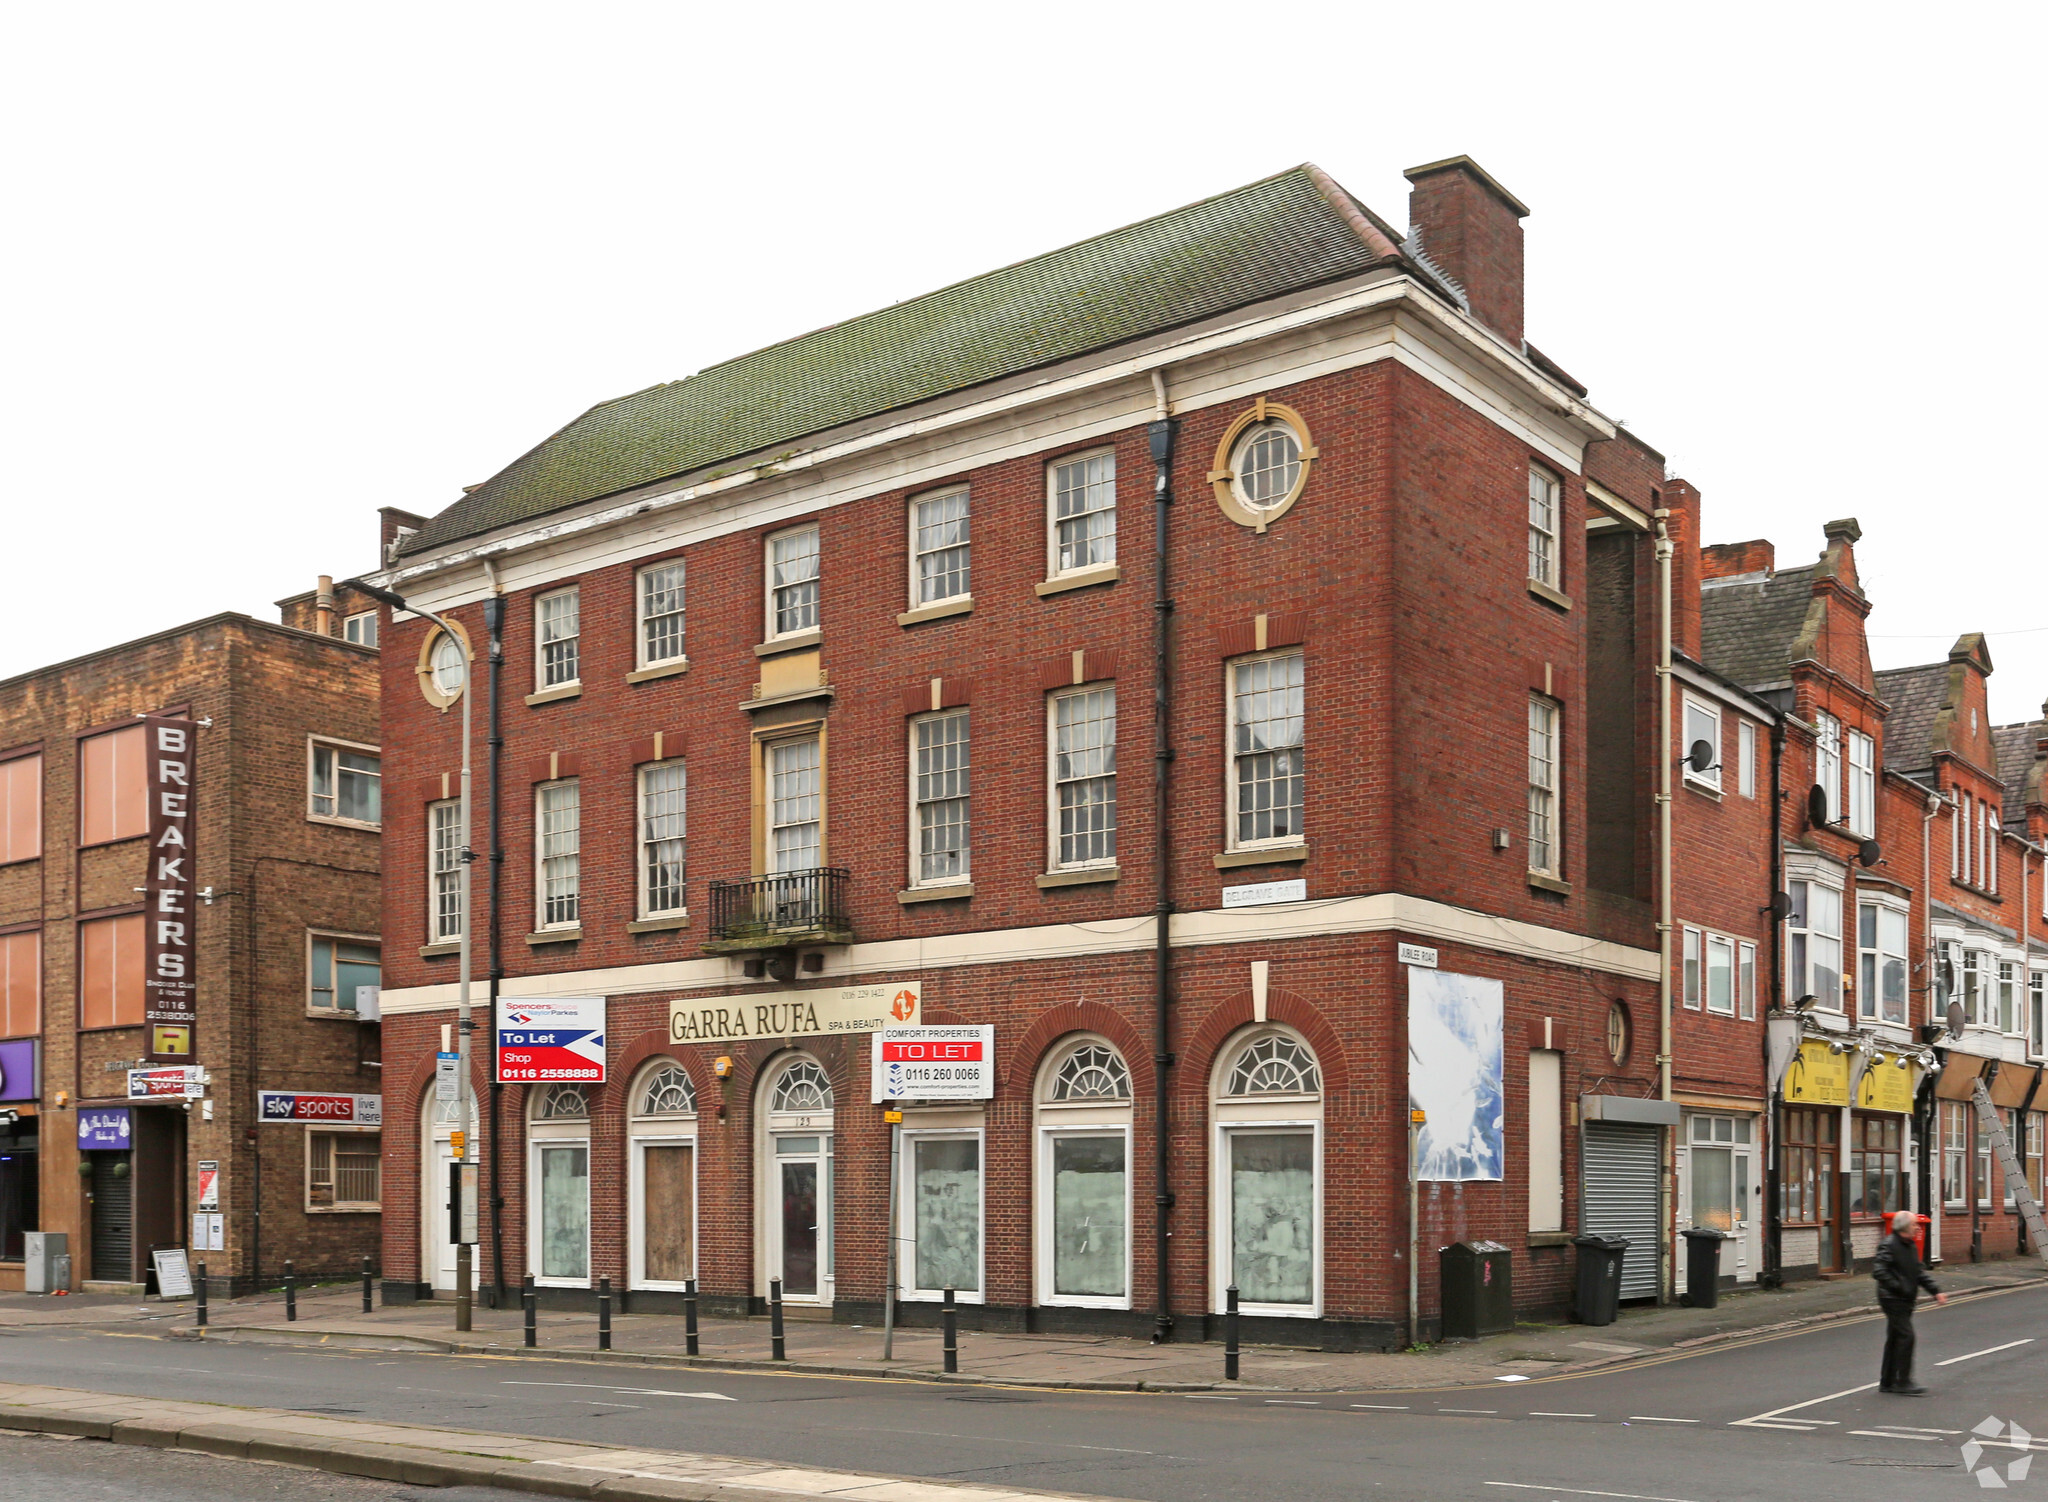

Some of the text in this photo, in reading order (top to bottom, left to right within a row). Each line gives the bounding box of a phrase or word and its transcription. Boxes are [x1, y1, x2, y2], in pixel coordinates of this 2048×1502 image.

[157, 727, 189, 978] BREAKERS
[1226, 885, 1303, 903] BELGRAVE GATE
[1401, 947, 1436, 963] JUBILEE ROAD
[158, 1000, 186, 1010] 0116
[671, 1001, 821, 1040] GARRA RUFA
[828, 1018, 885, 1031] SPA & BEAUTY
[502, 1032, 556, 1044] To Let
[885, 1029, 980, 1038] COMFORT PROPERTIES
[892, 1044, 974, 1058] TO LET
[504, 1052, 532, 1064] Shop
[502, 1068, 599, 1079] 0116 2558888
[905, 1068, 980, 1080] 0116 260 0066
[266, 1097, 351, 1117] sky sports
[358, 1098, 376, 1109] live
[358, 1112, 381, 1122] here
